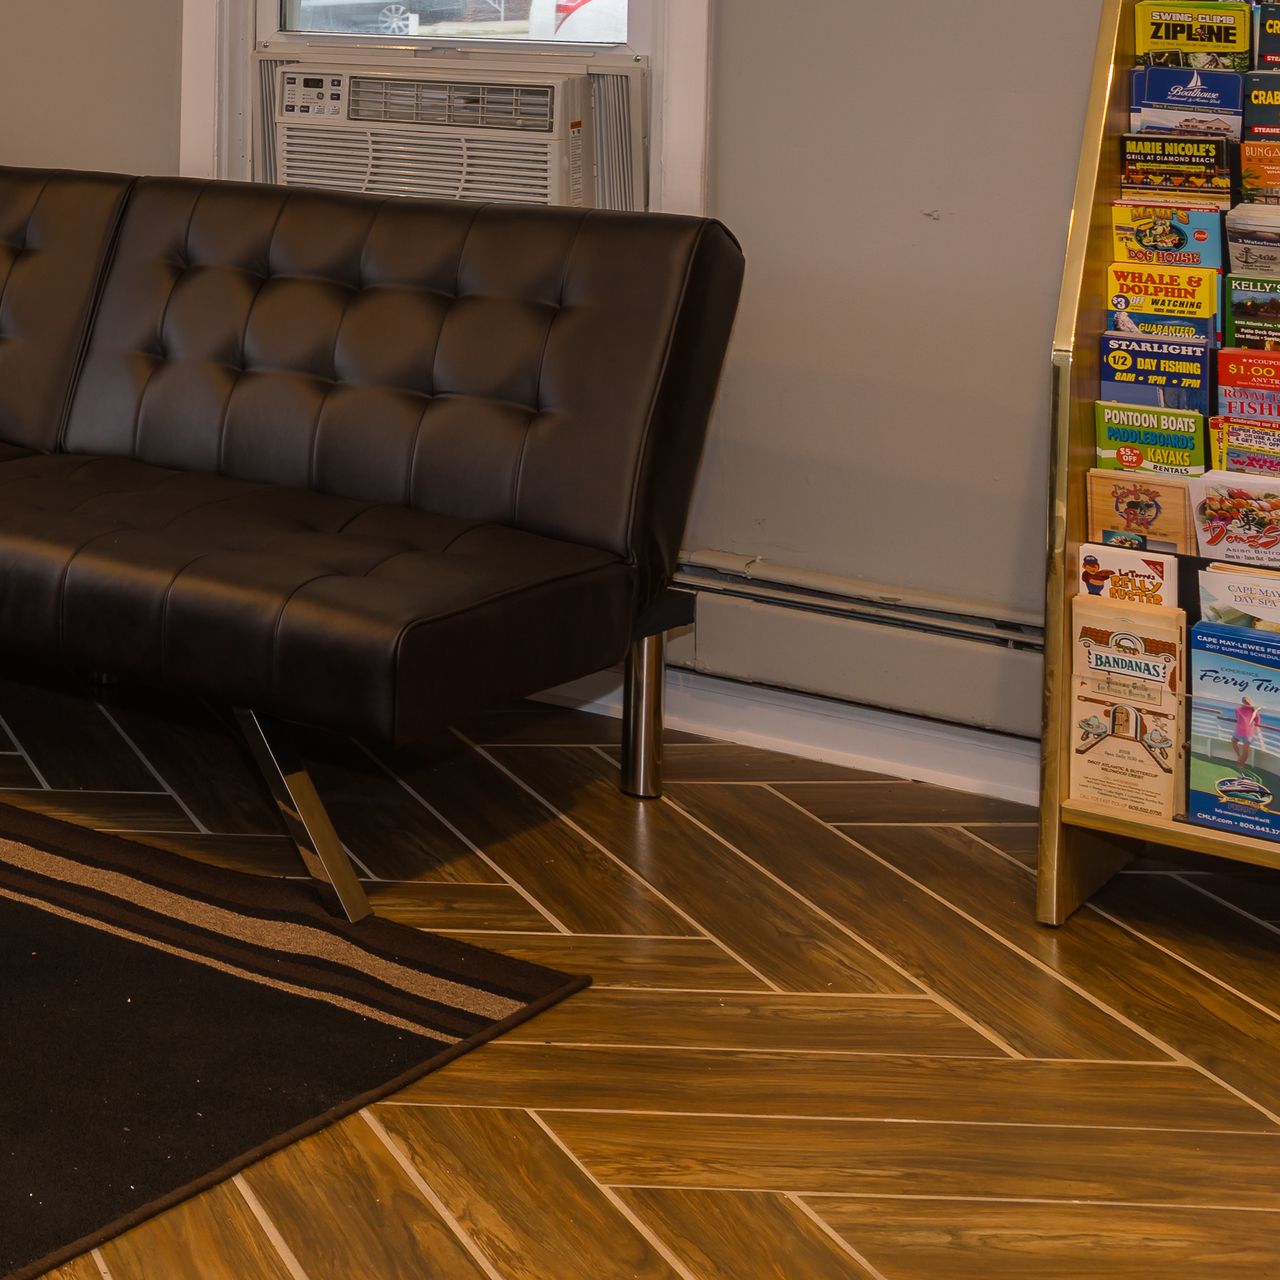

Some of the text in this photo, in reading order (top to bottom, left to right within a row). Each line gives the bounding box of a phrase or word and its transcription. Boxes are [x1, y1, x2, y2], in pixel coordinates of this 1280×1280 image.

[1151, 11, 1235, 24] SWING CLIMB
[1150, 21, 1237, 44] ZIPLINE
[1167, 85, 1220, 99] Boathouse
[1126, 140, 1216, 157] MARIE NICOLE'S
[1156, 155, 1190, 163] DIAMOND
[1191, 156, 1215, 164] BEACH
[1128, 248, 1201, 265] DOG HOUSE
[1112, 270, 1203, 288] WHALE &
[1119, 282, 1197, 299] DOLPHIN
[1112, 296, 1126, 309] $3
[1130, 295, 1145, 305] OFF
[1151, 298, 1202, 309] WATCHING
[1139, 322, 1196, 335] GUARANTEED
[1108, 339, 1205, 357] STARLIGHT
[1111, 355, 1201, 375] 1/2 DAY FISHING
[1228, 363, 1276, 377] $1.00
[1114, 371, 1201, 388] 8AM 1PM 7PM
[1223, 388, 1266, 401] ROYAL
[1104, 408, 1197, 433] PONTOON BOATS
[1107, 426, 1195, 450] PADDLEBOARDS
[1122, 453, 1138, 462] OFF
[1147, 447, 1191, 466] KAYAKS
[1152, 464, 1190, 475] RENTALS
[1111, 575, 1163, 594] BELLY
[1227, 584, 1257, 595] CAPE
[1234, 595, 1277, 608] DAY SPA
[1196, 634, 1218, 644] CAPE
[1219, 638, 1265, 653] MAY-LEWES
[1221, 646, 1249, 655] SUMMER
[1094, 653, 1160, 678] BANDANAS
[1199, 669, 1249, 693] Ferry
[1196, 812, 1233, 825] CMLF.com
